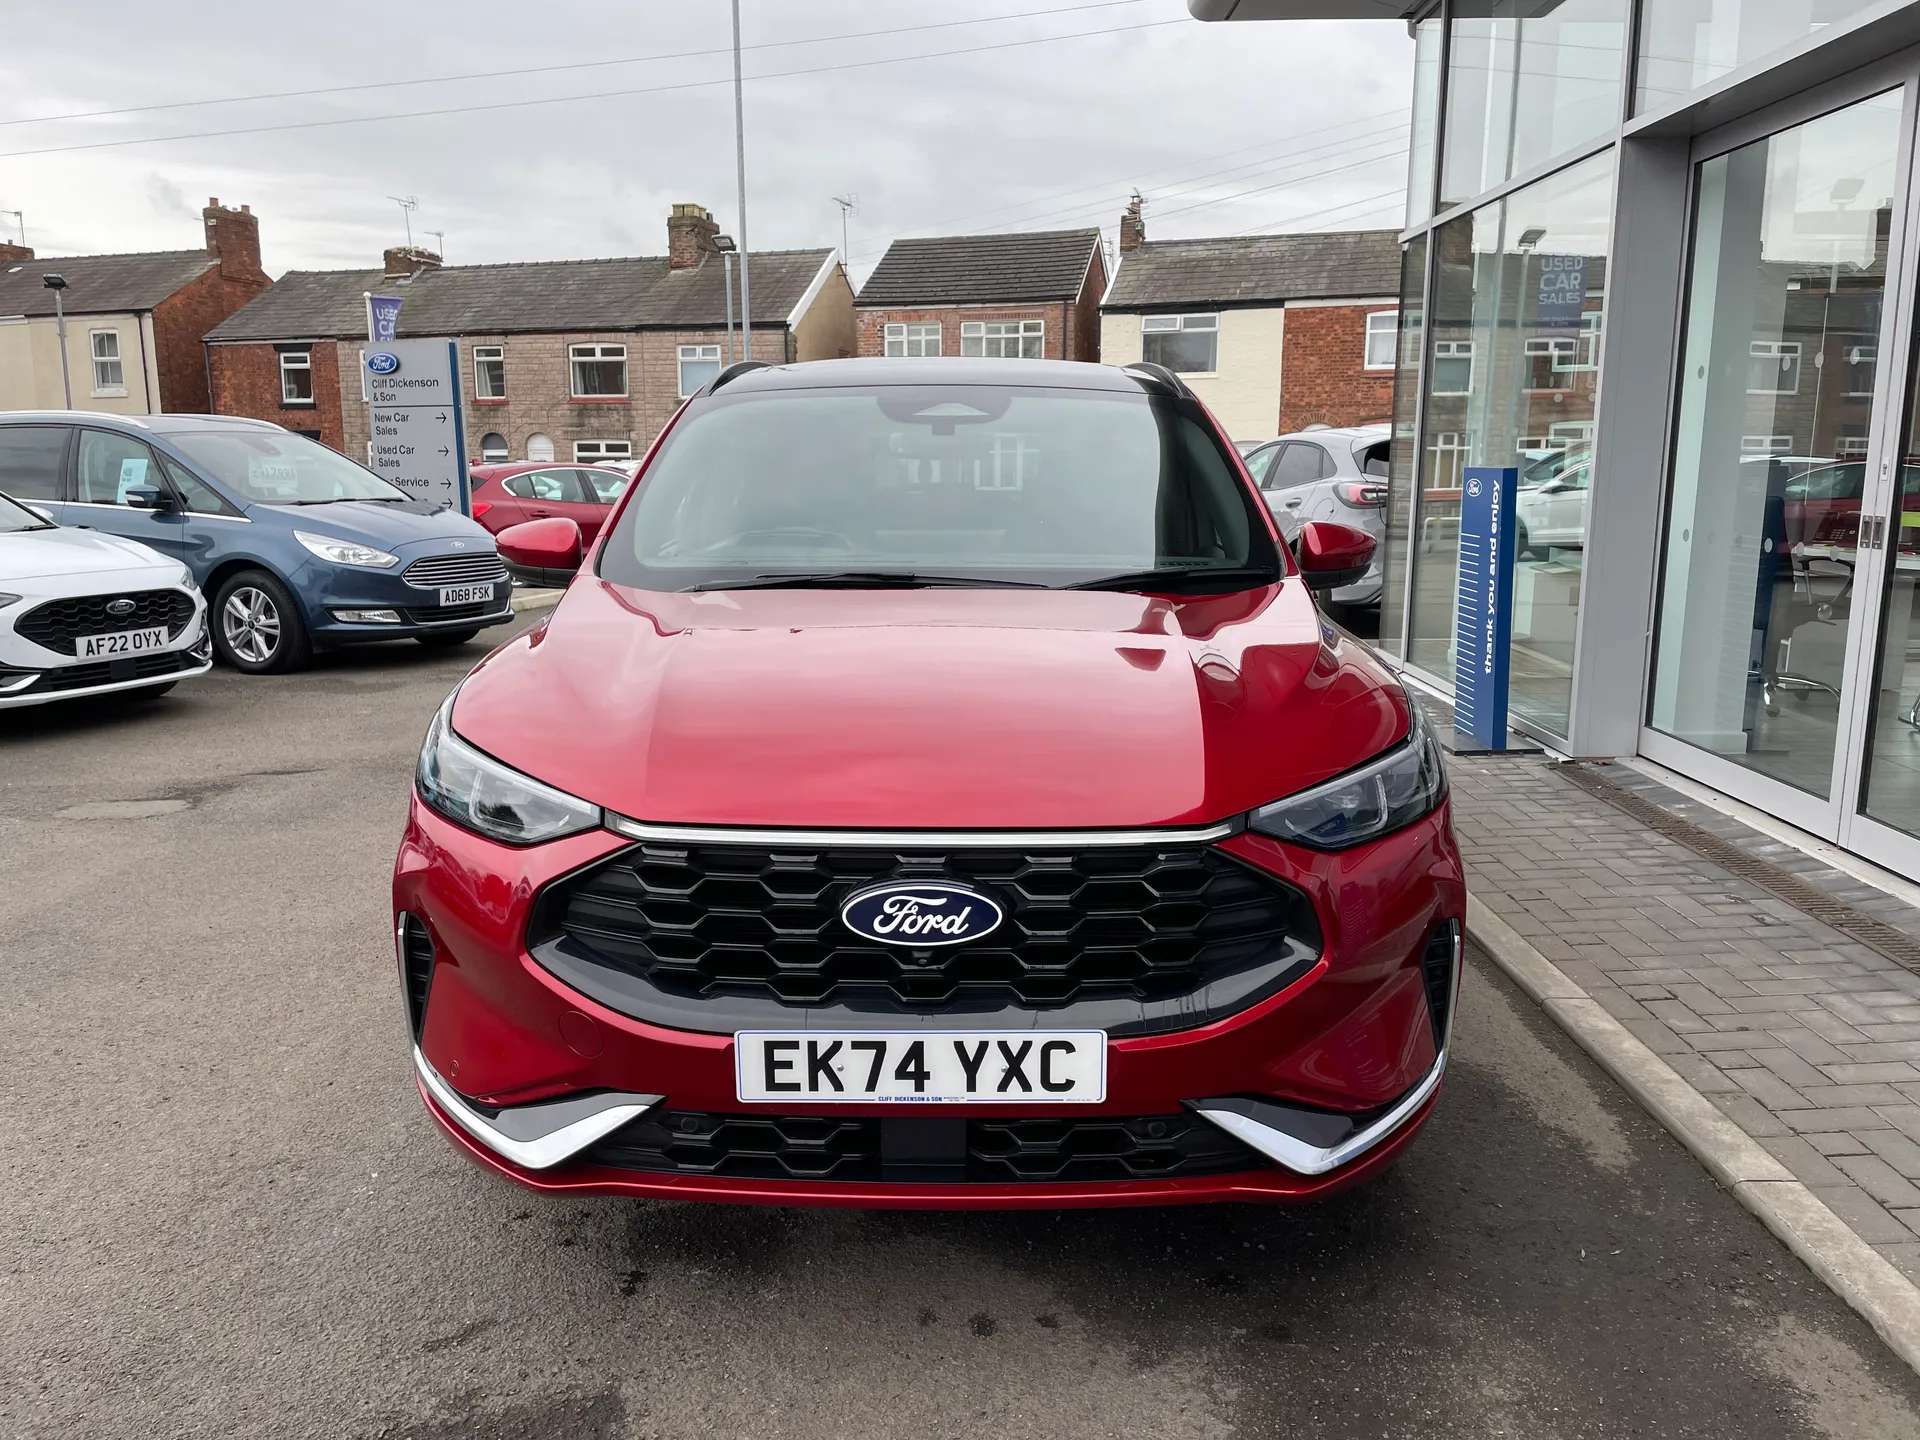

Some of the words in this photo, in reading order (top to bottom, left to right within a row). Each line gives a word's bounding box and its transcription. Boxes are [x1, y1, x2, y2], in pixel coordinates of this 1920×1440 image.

[1541, 256, 1583, 271] USED
[1540, 273, 1581, 291] CAR
[1538, 292, 1581, 305] SALES
[372, 356, 391, 370] Ford
[371, 378, 388, 389] Cliff
[389, 376, 439, 389] Dickenson
[373, 391, 379, 402] &
[380, 391, 397, 402] Son
[374, 412, 392, 423] New
[393, 412, 410, 422] Car
[375, 425, 398, 436] Sales
[377, 445, 398, 455] Used
[398, 445, 415, 455] Car
[378, 457, 401, 467] Sales
[394, 476, 430, 487] Service
[1490, 479, 1500, 534] enjoy
[1488, 537, 1497, 576] and
[444, 588, 470, 604] AD68
[472, 586, 490, 600] FSK
[1486, 579, 1496, 615] you
[85, 635, 129, 657] AF22
[132, 630, 163, 650] OYX
[1484, 618, 1495, 674] thank
[872, 895, 972, 935] Ford
[763, 1040, 931, 1093] EK74
[952, 1040, 1077, 1093] YXC
